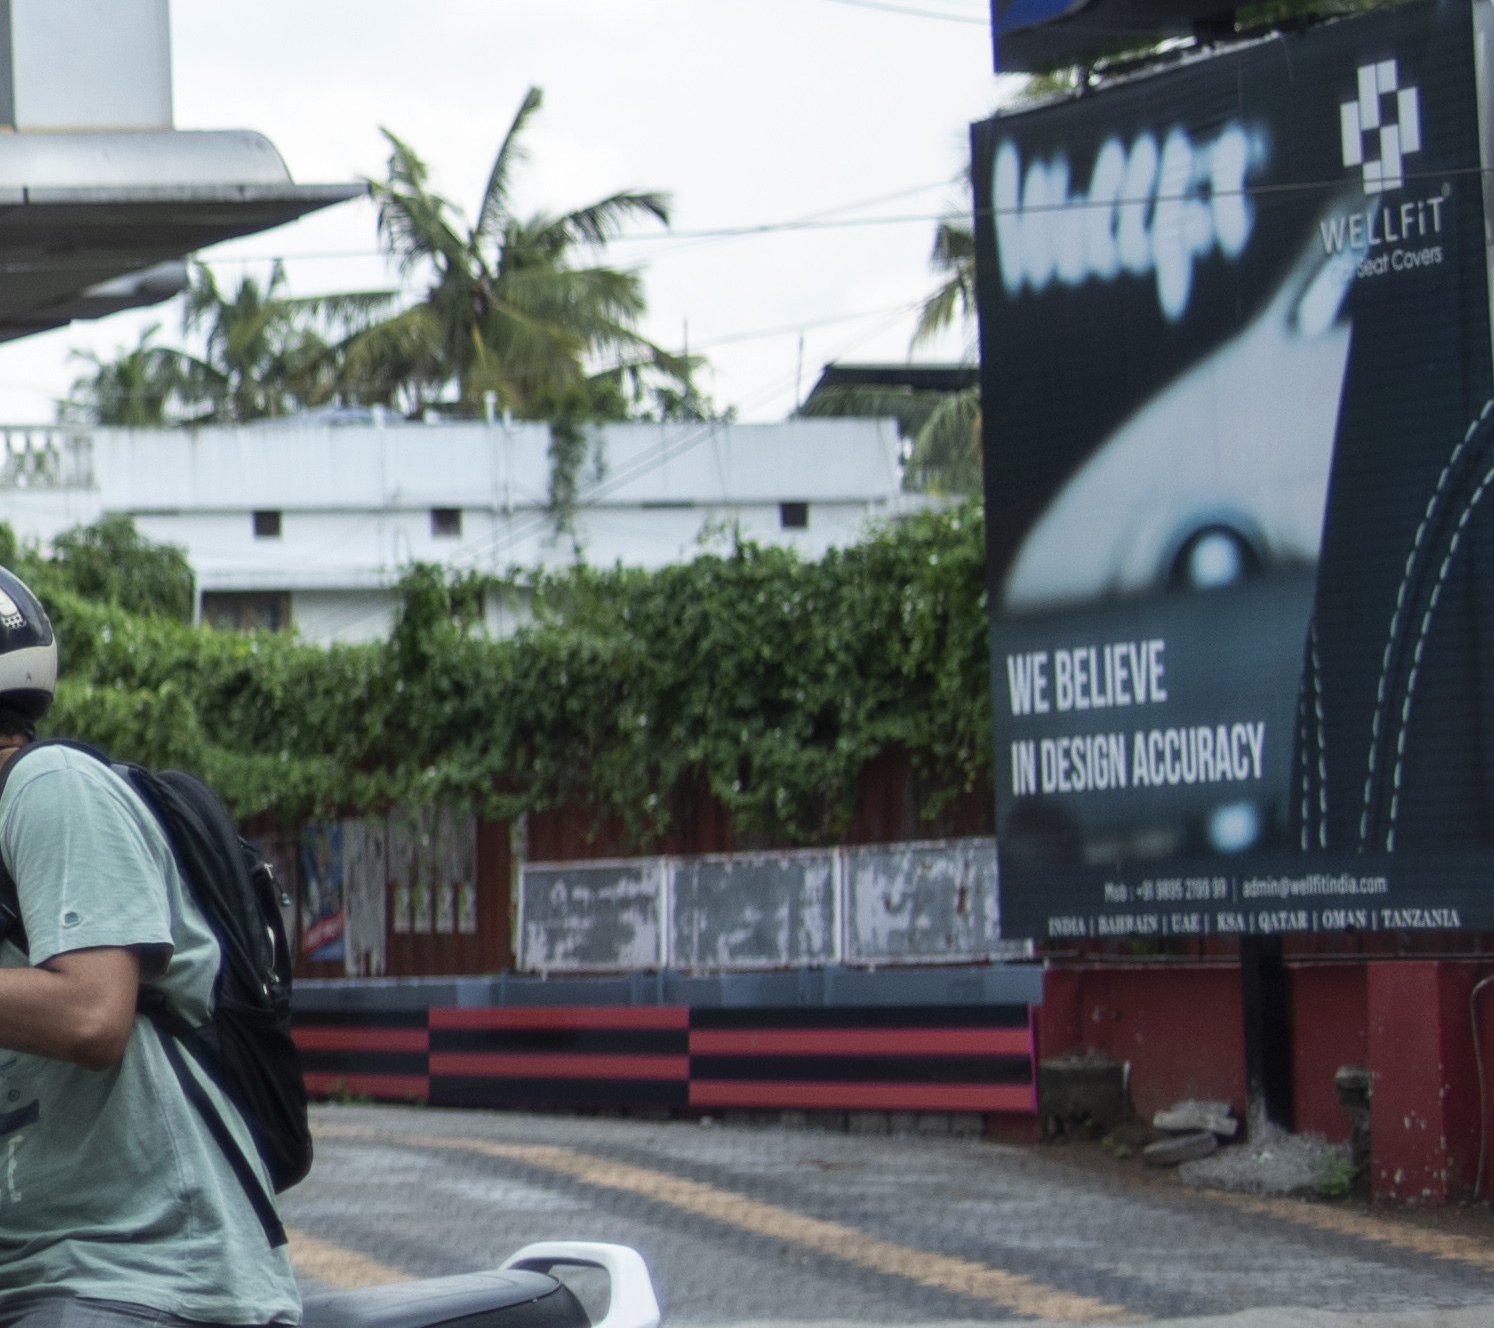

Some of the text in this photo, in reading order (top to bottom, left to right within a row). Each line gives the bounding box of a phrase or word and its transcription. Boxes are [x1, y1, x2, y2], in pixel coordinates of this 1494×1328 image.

[1007, 639, 1168, 716] WE BELIEVE
[1010, 722, 1266, 797] IN DESIGN ACCURACY
[1258, 910, 1309, 933] QATAR
[1322, 909, 1367, 929] OMAN
[1381, 907, 1461, 929] TANZANIA
